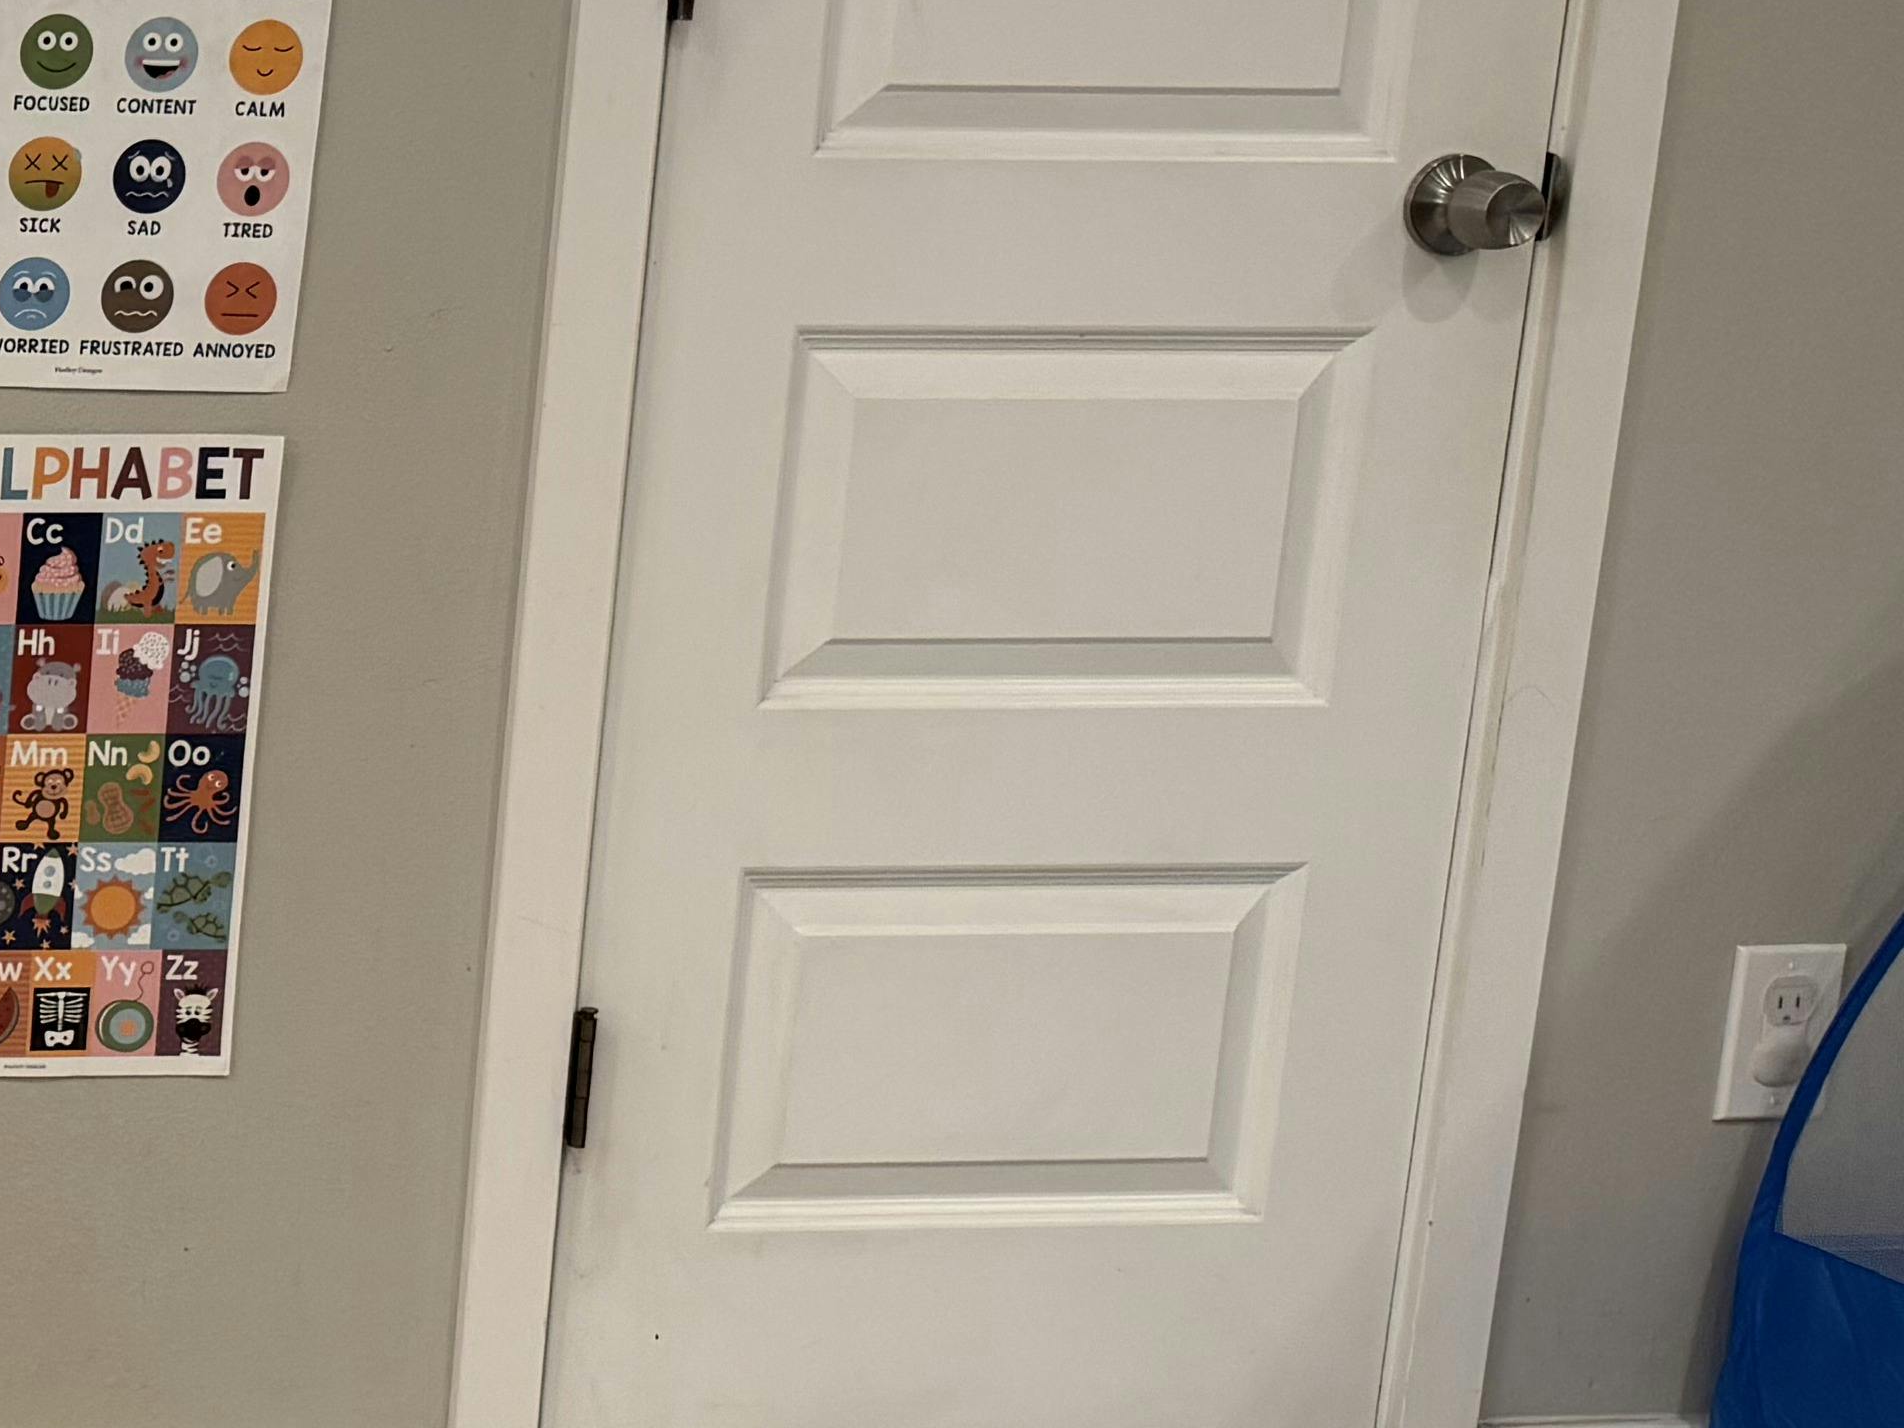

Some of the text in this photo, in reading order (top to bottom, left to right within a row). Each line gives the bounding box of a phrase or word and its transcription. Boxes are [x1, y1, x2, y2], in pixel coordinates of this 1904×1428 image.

[13, 95, 89, 112] FOCUSED
[116, 98, 196, 115] CONTENT
[235, 101, 286, 118] CALM
[19, 217, 61, 233] SICK
[127, 220, 161, 236] SAD
[223, 223, 273, 238] TIRED
[80, 340, 183, 357] FRUSTRATED
[193, 342, 275, 359] ANNOYED
[26, 518, 63, 545] Cc
[105, 517, 144, 544] Dd
[168, 741, 211, 767] Oo
[165, 955, 198, 981] Zz
